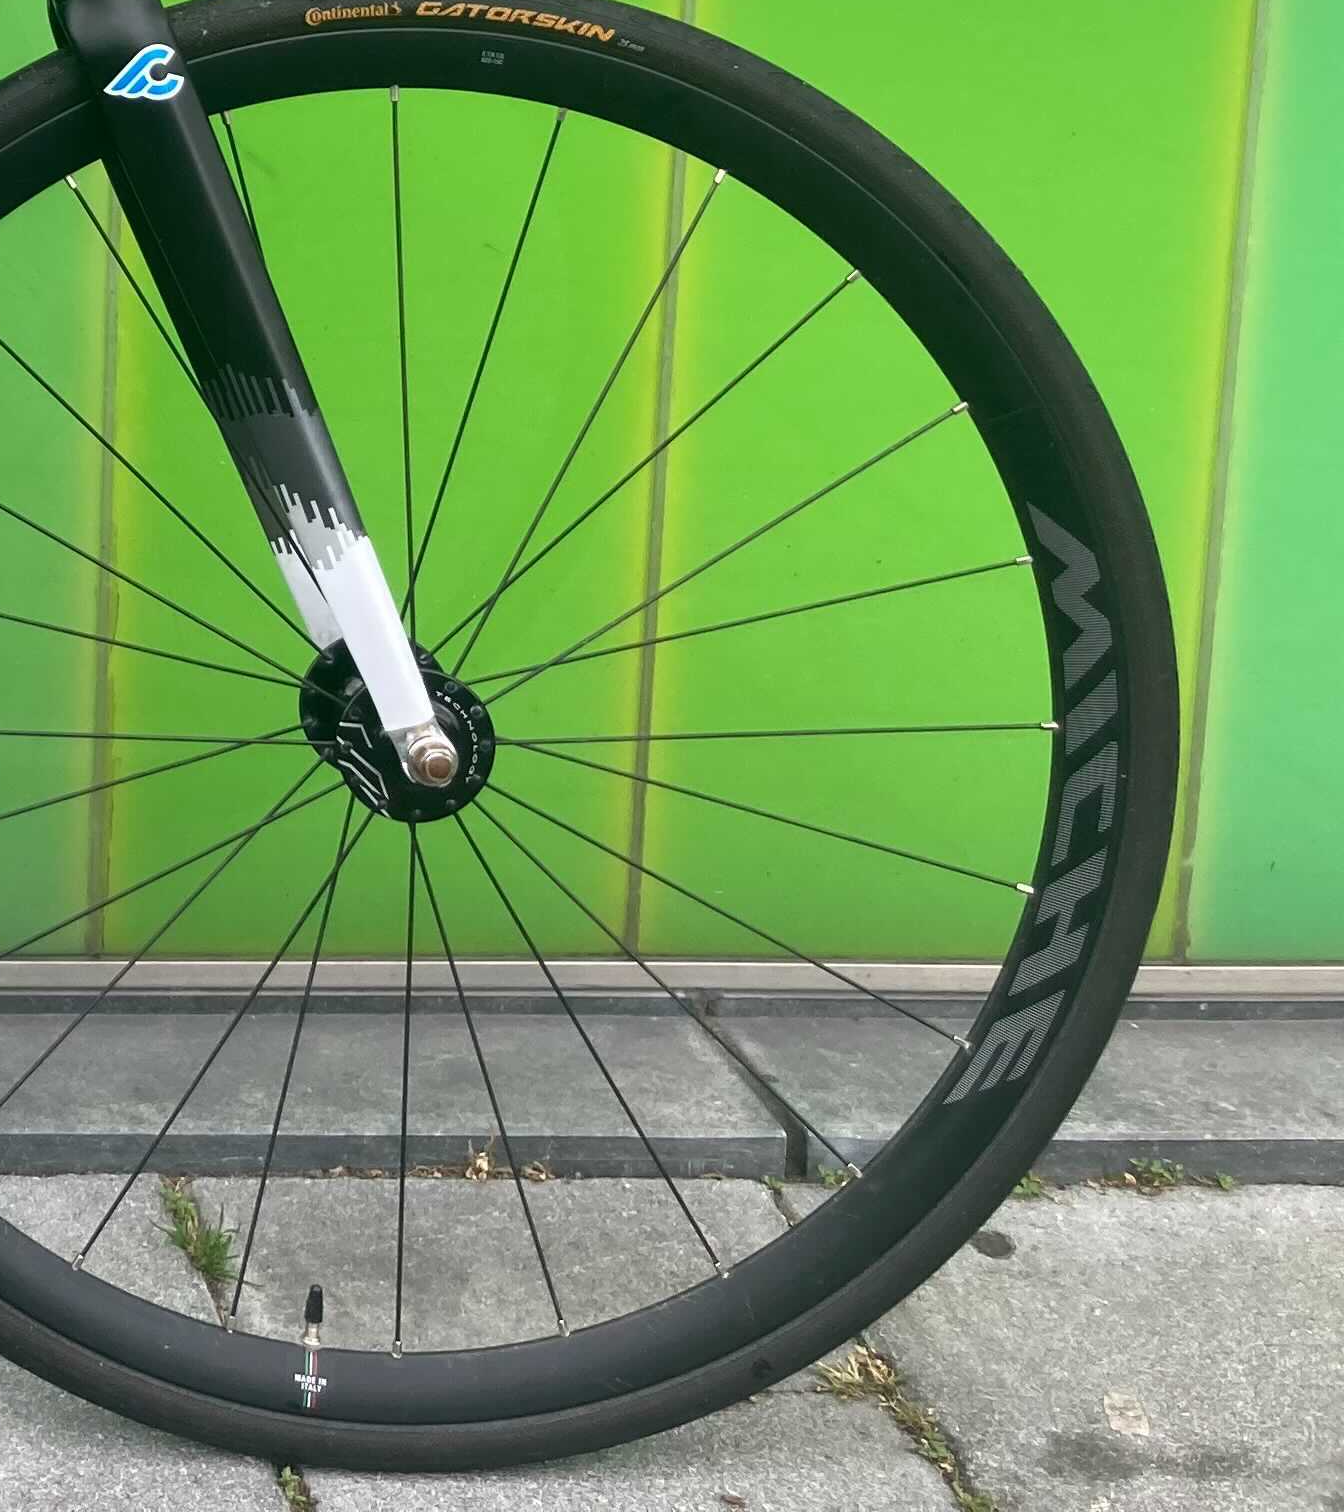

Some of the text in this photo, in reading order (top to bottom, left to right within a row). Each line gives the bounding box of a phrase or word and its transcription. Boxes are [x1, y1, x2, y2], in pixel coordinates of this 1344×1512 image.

[304, 1, 616, 43] Continental GATORSKIN
[941, 500, 1120, 1105] MICHE
